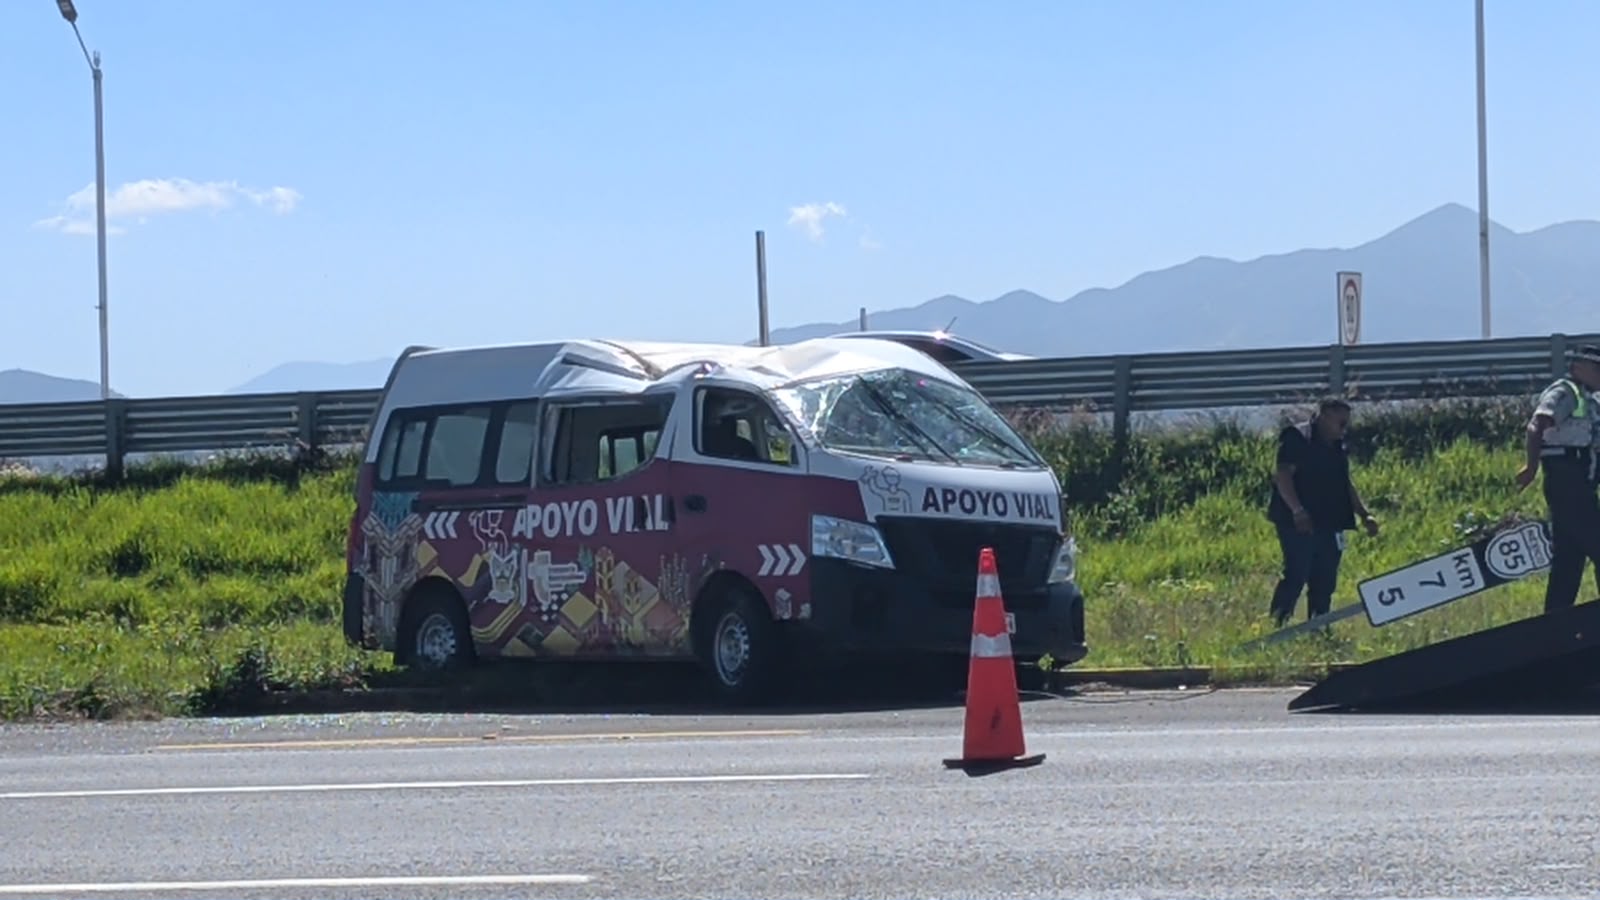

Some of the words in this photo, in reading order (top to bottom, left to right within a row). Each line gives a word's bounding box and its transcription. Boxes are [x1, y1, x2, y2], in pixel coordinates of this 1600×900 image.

[512, 498, 598, 539] APOYO
[922, 487, 1008, 517] APOYO
[1012, 492, 1055, 520] VIAL
[1452, 552, 1476, 590] km
[1499, 539, 1527, 571] 85
[1378, 586, 1405, 606] 5
[1419, 571, 1447, 590] 7
